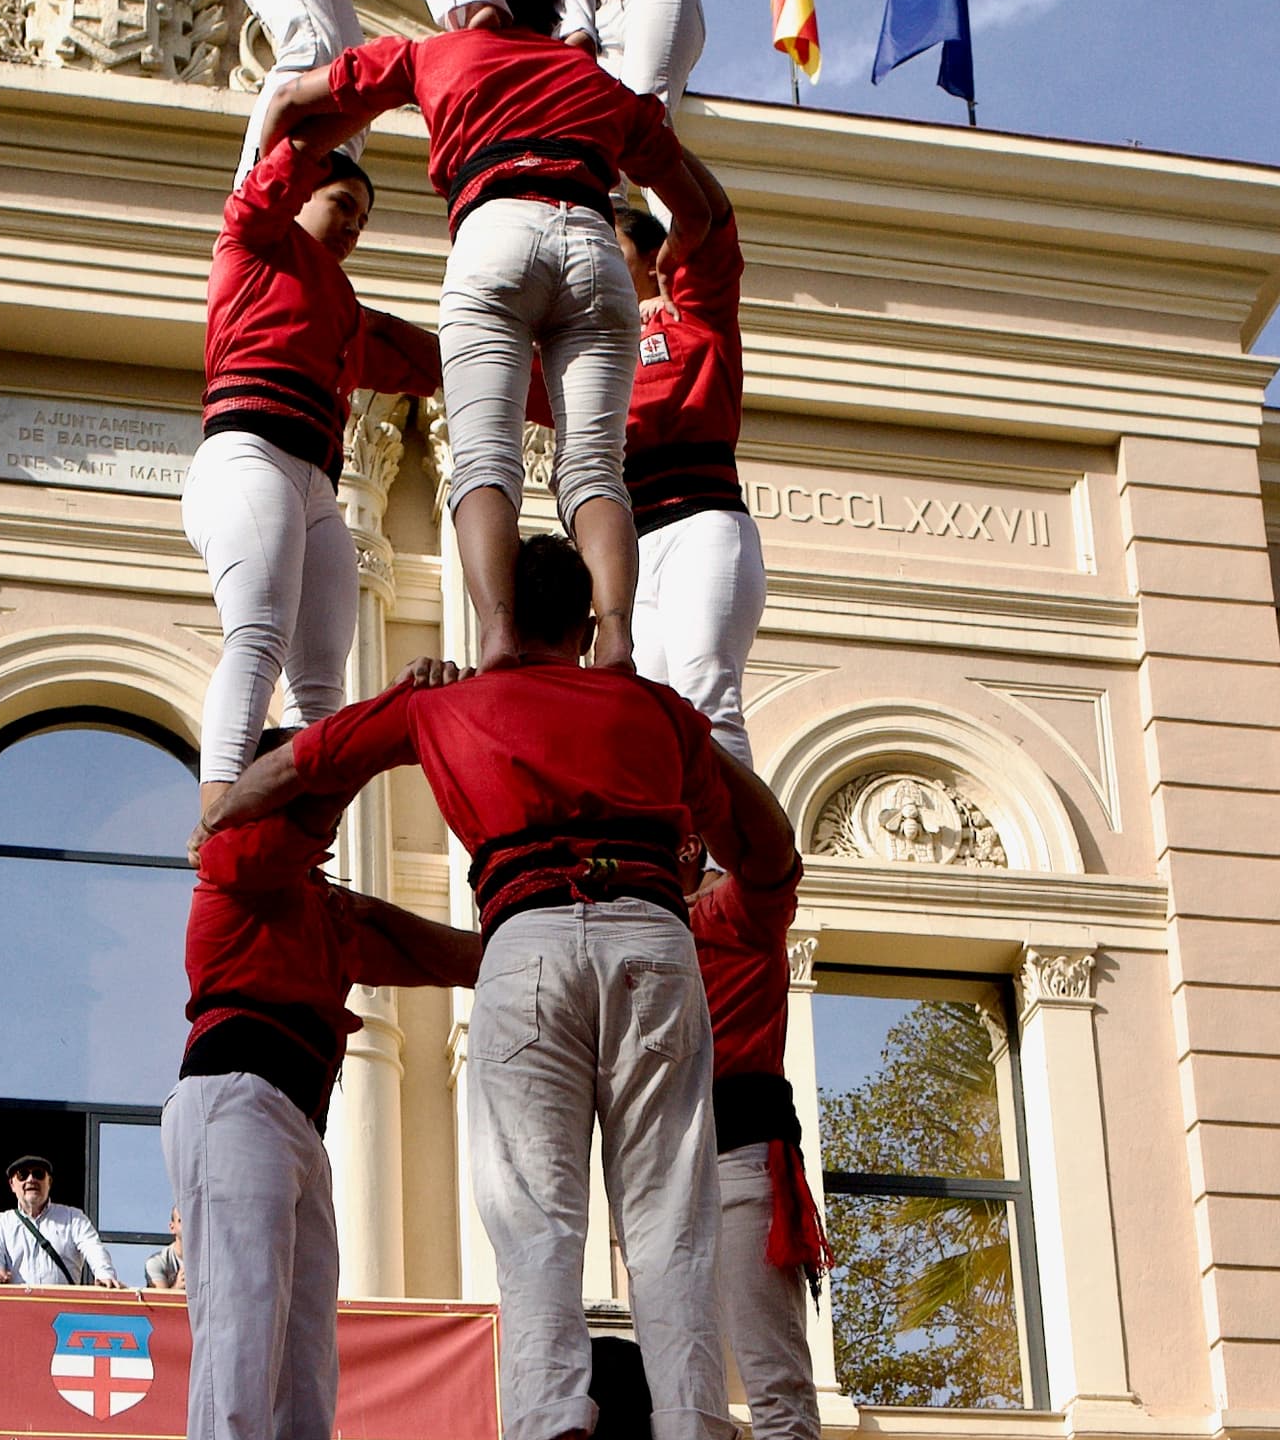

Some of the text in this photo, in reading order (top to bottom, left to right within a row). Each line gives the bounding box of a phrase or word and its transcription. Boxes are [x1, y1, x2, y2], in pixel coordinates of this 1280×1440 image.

[33, 410, 166, 436] AJUNTAMENT
[18, 427, 179, 455] DE BARCELONA
[7, 453, 190, 484] DTE. SANT MART
[739, 479, 1050, 548] DCCCLXXXVII
